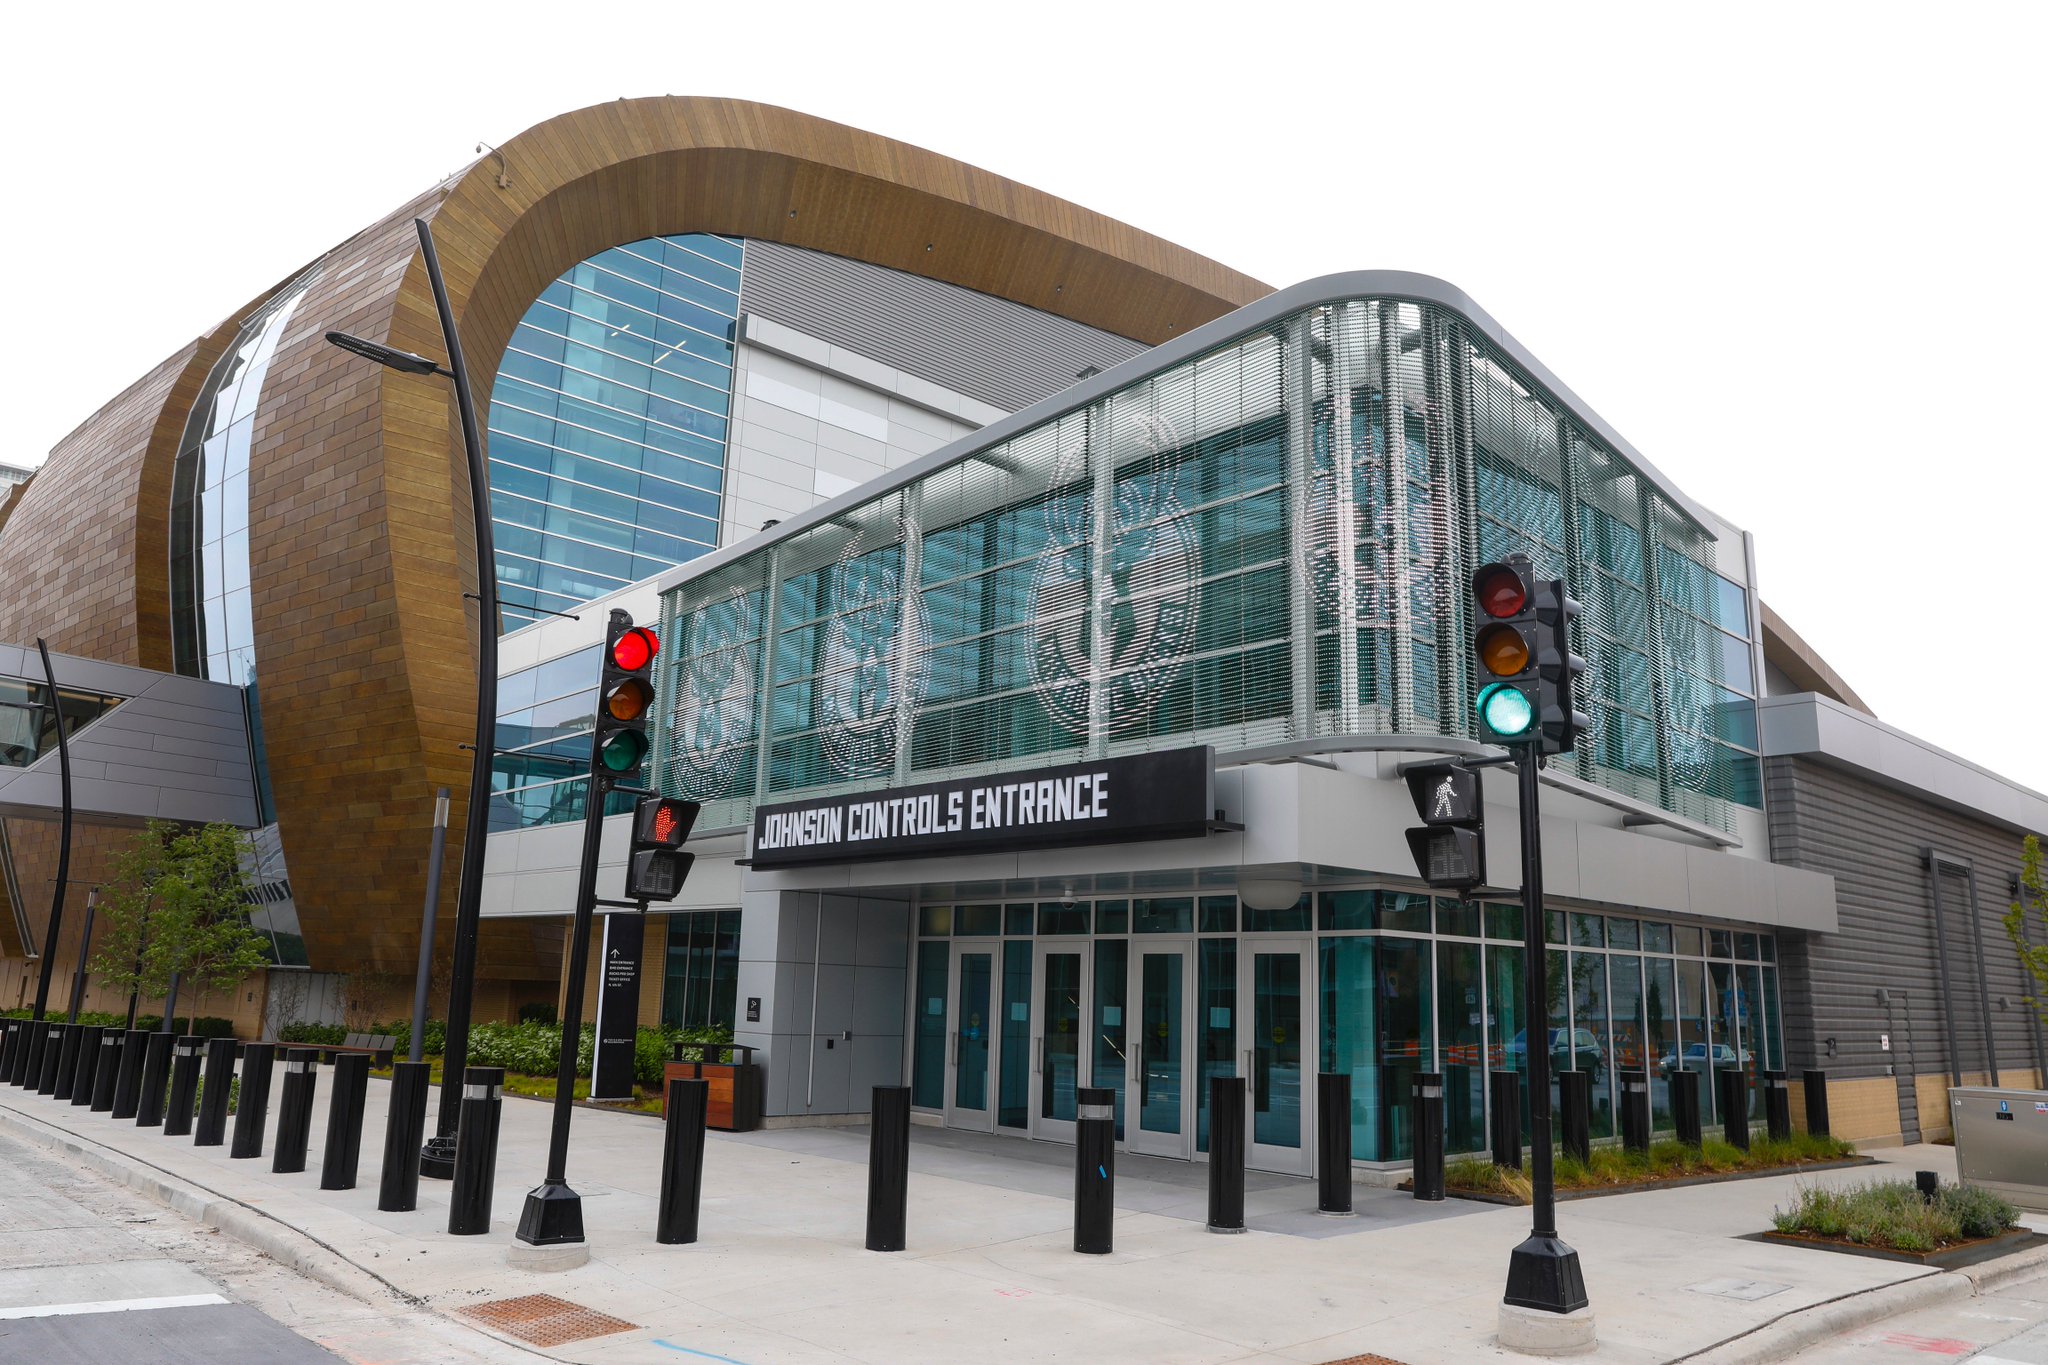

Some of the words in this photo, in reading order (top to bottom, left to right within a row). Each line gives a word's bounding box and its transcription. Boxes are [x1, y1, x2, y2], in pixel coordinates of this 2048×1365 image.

[758, 807, 843, 849] JOHNSON
[847, 792, 963, 841] CONTROLS
[970, 773, 1108, 829] ENTRANCE
